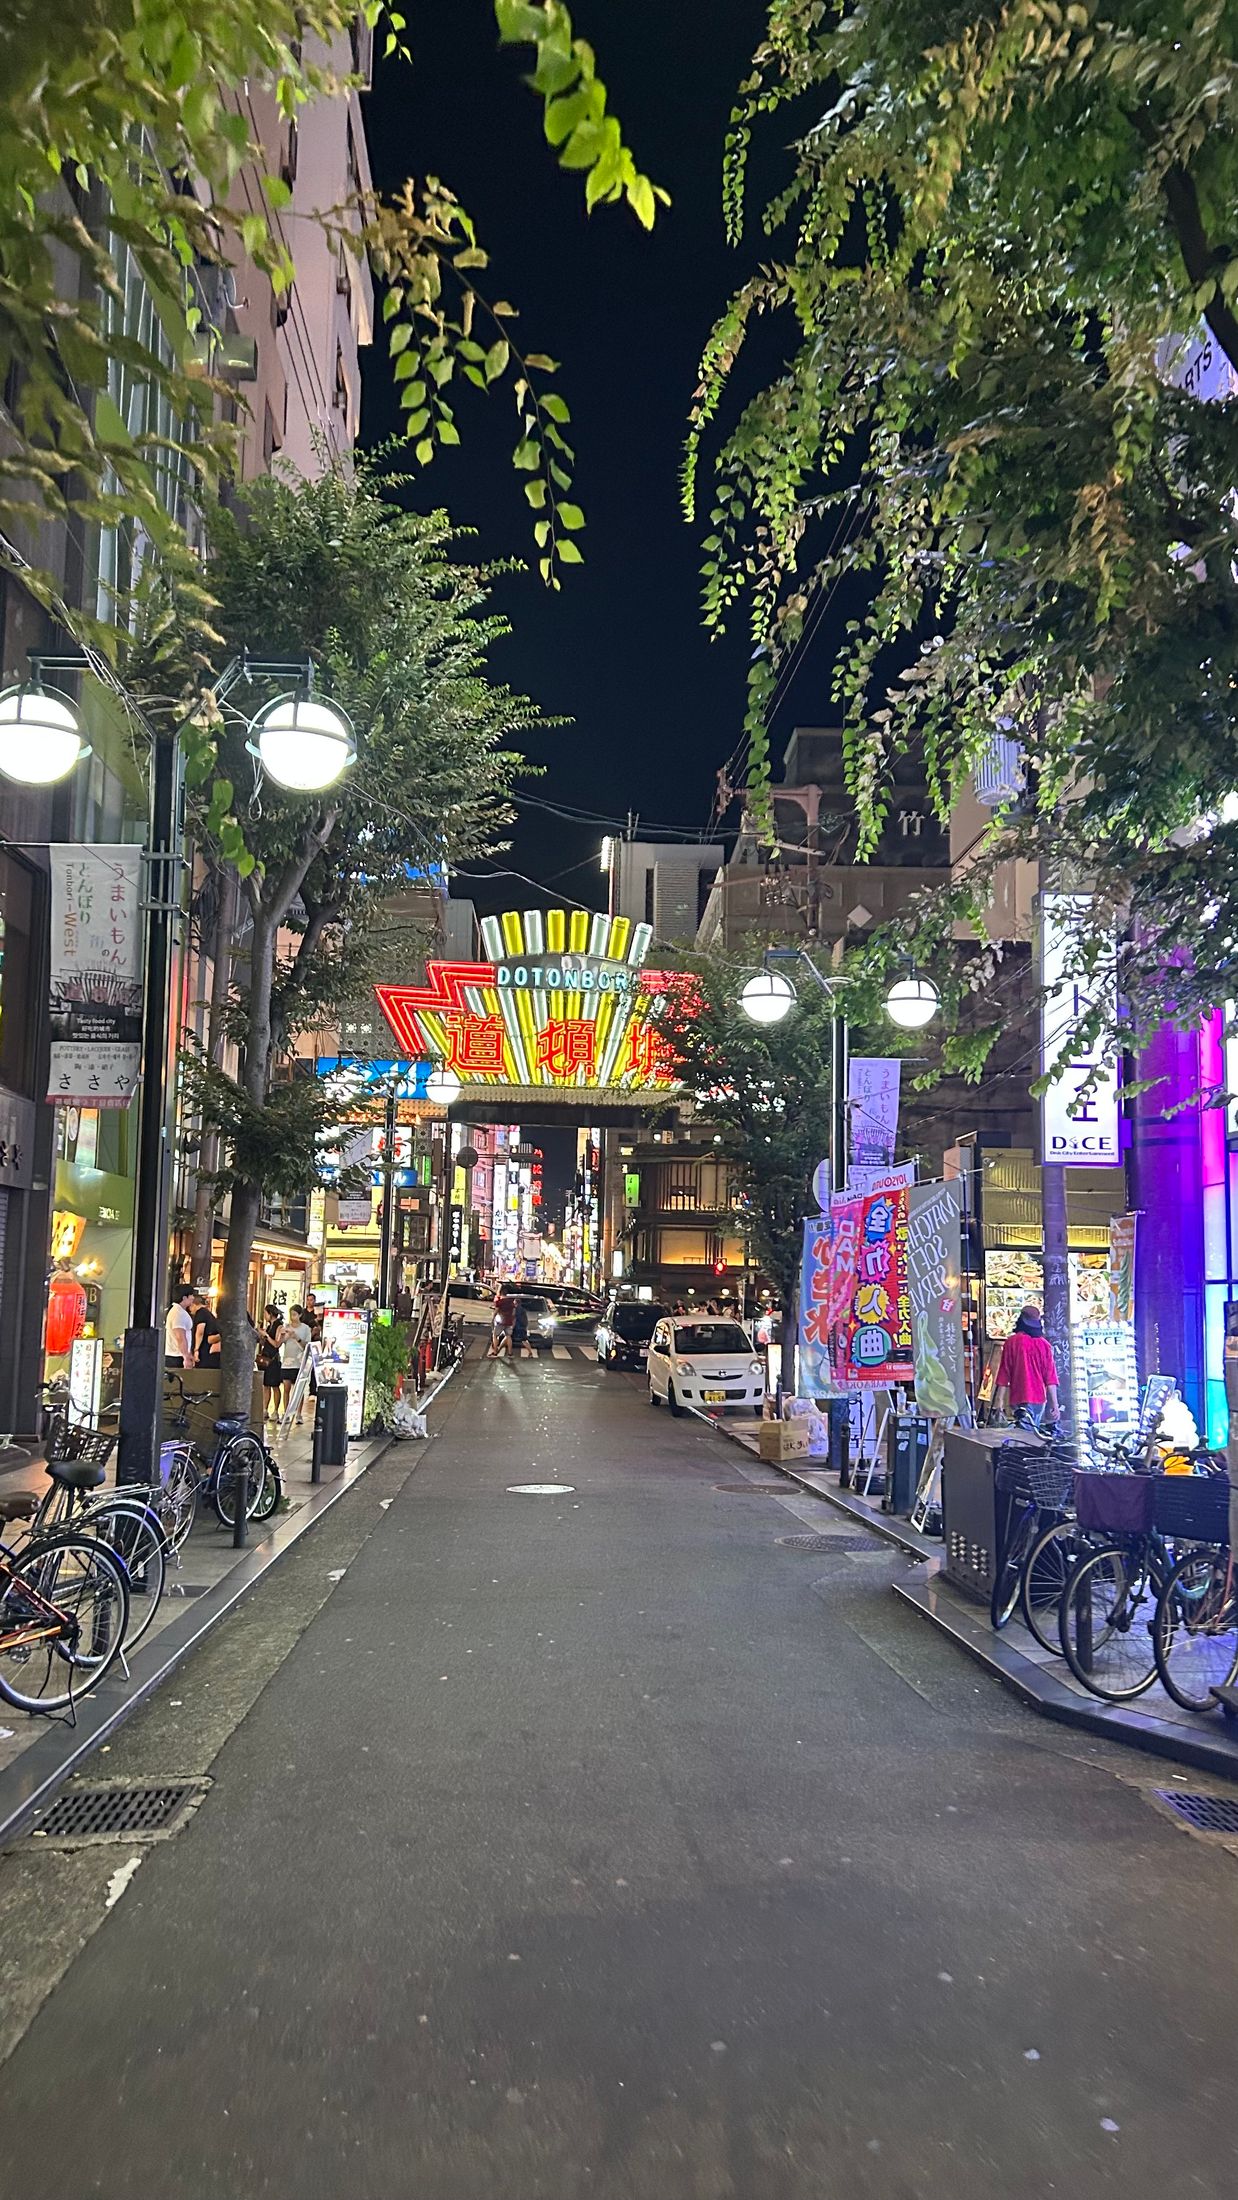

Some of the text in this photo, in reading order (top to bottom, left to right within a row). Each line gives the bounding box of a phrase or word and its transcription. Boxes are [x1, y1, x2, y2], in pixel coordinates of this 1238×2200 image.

[1178, 341, 1213, 391] RTS
[109, 862, 128, 966] うまいもん
[59, 1073, 130, 1091] ささや
